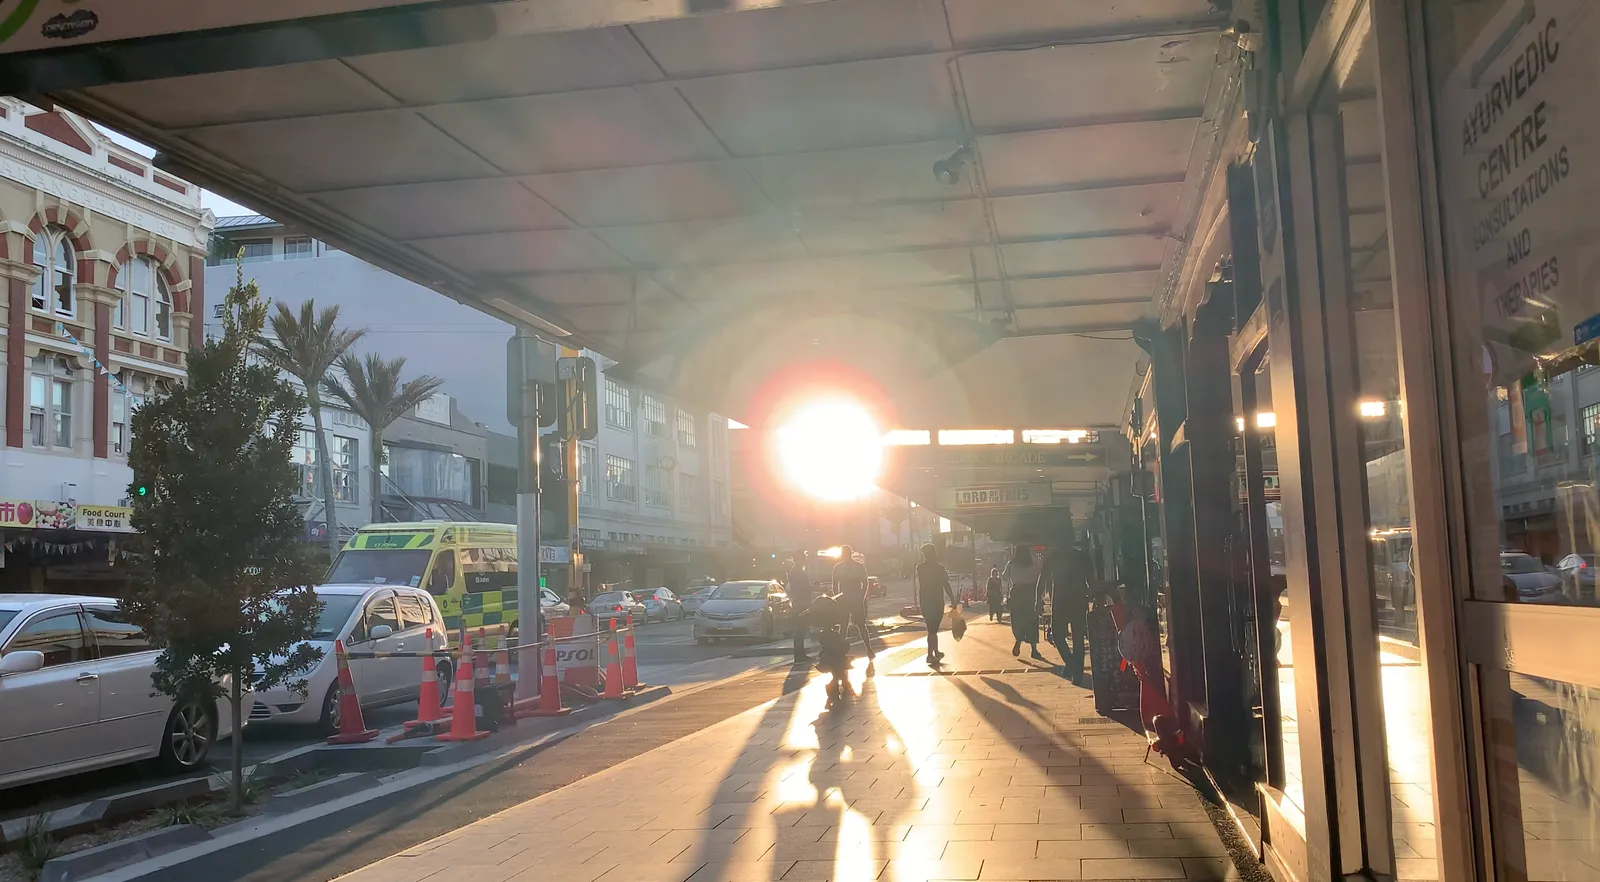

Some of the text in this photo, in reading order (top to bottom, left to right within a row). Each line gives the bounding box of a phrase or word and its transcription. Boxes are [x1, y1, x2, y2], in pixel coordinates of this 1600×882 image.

[1463, 17, 1560, 156] AYURVEDIC
[1478, 101, 1547, 199] CENTRE
[1474, 145, 1570, 252] CONSULTATIONS
[1507, 228, 1531, 269] AND
[1497, 255, 1560, 321] THERAPIES
[82, 508, 126, 519] Food Court
[955, 490, 988, 504] LORD
